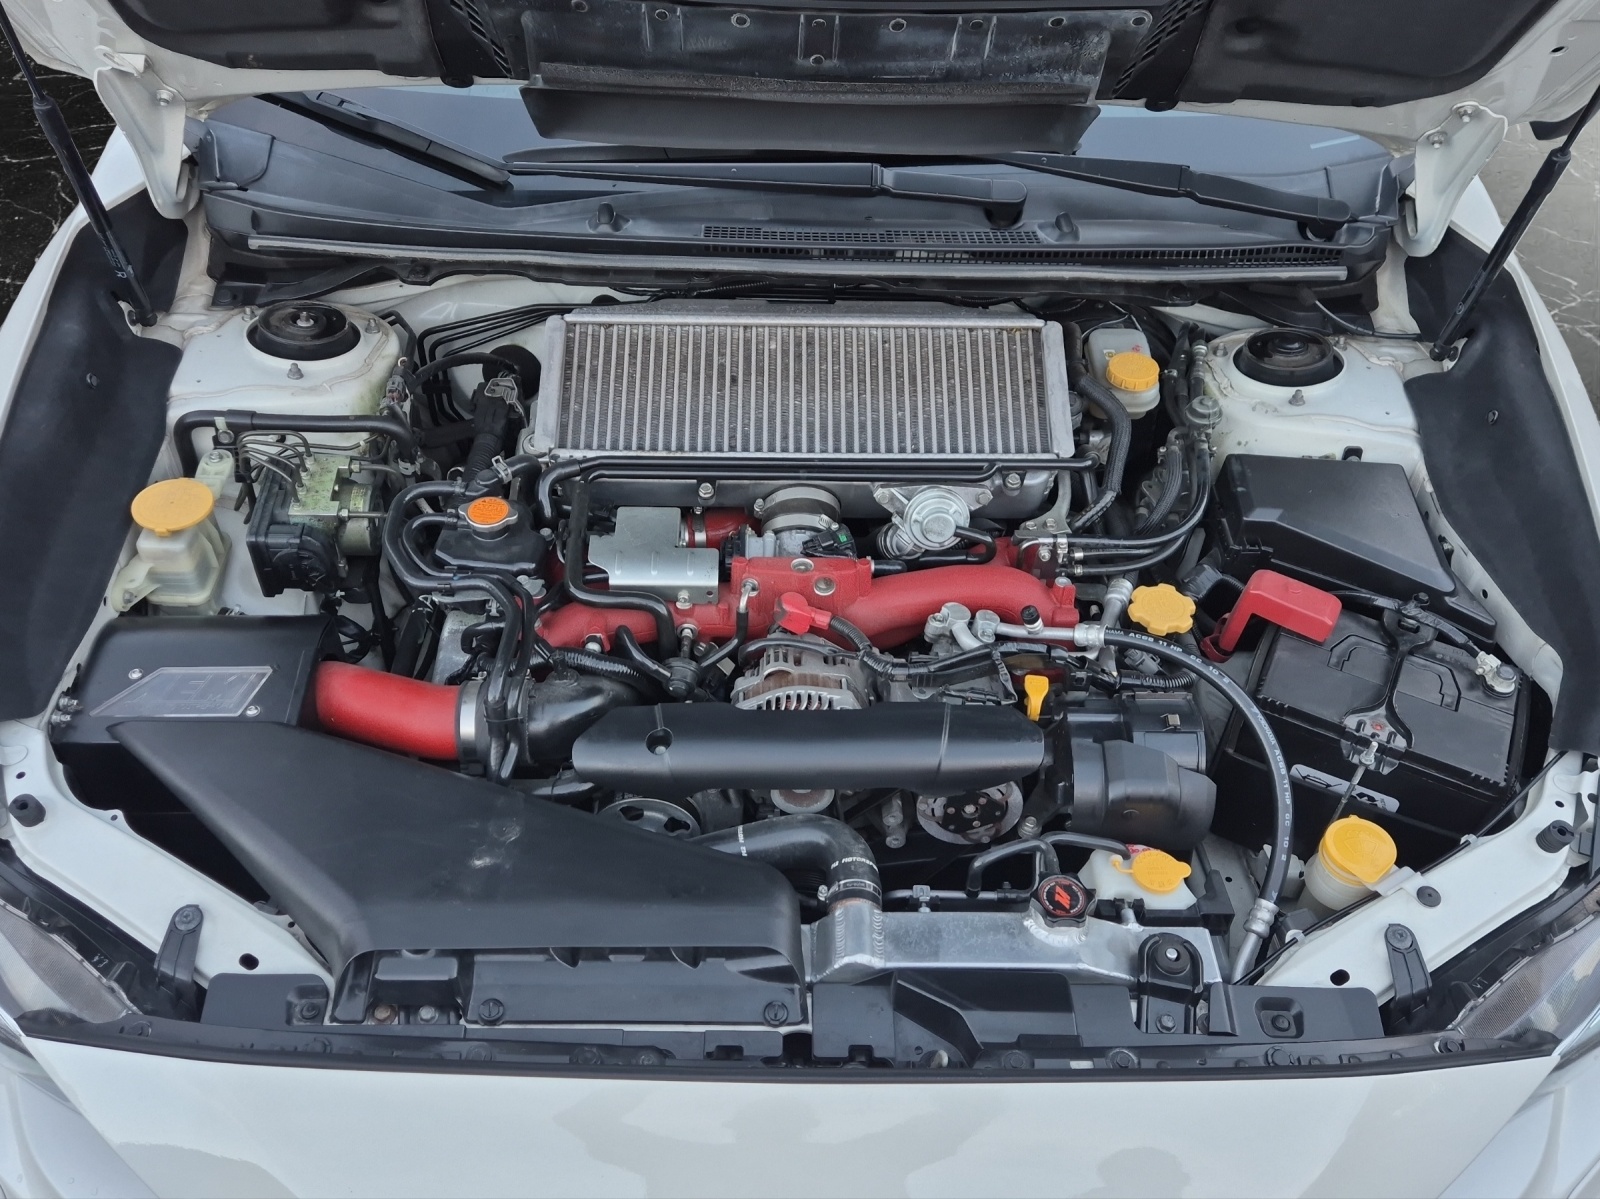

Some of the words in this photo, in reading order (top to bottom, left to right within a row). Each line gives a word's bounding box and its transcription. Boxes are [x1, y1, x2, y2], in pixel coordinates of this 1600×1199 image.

[1158, 640, 1168, 648] 11
[1170, 644, 1183, 653] HP
[1208, 665, 1220, 676] 10
[1256, 714, 1276, 745] YOKOHAMA
[1283, 779, 1289, 788] 11
[1284, 792, 1291, 805] HP
[1283, 836, 1289, 848] 10
